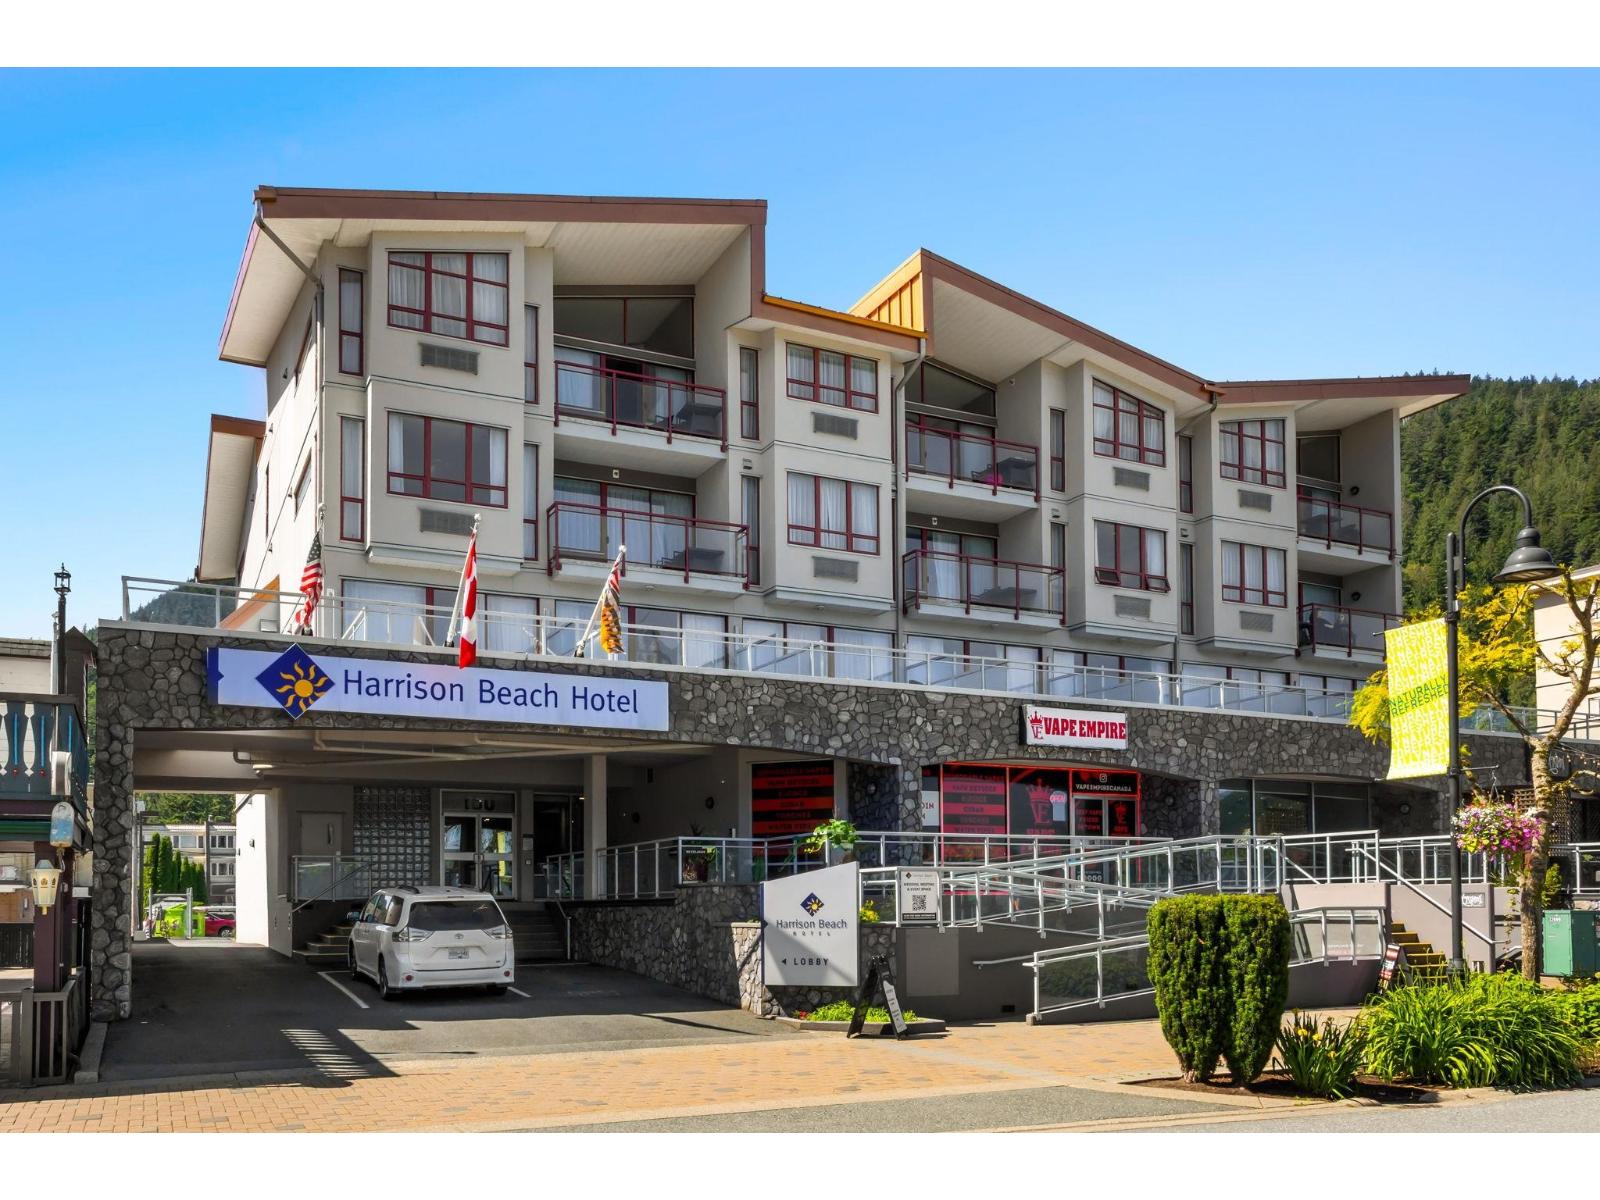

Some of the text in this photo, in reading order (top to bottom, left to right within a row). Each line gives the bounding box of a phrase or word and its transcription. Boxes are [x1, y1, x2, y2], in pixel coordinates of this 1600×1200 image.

[344, 669, 639, 714] Harrison Beach Hotel
[1389, 674, 1448, 707] NATURALLY
[1391, 684, 1449, 718] REFRESHED
[1042, 717, 1126, 740] VAPE EMPIRE
[776, 918, 848, 929] Harrison Beach
[793, 958, 829, 966] LOBBY
